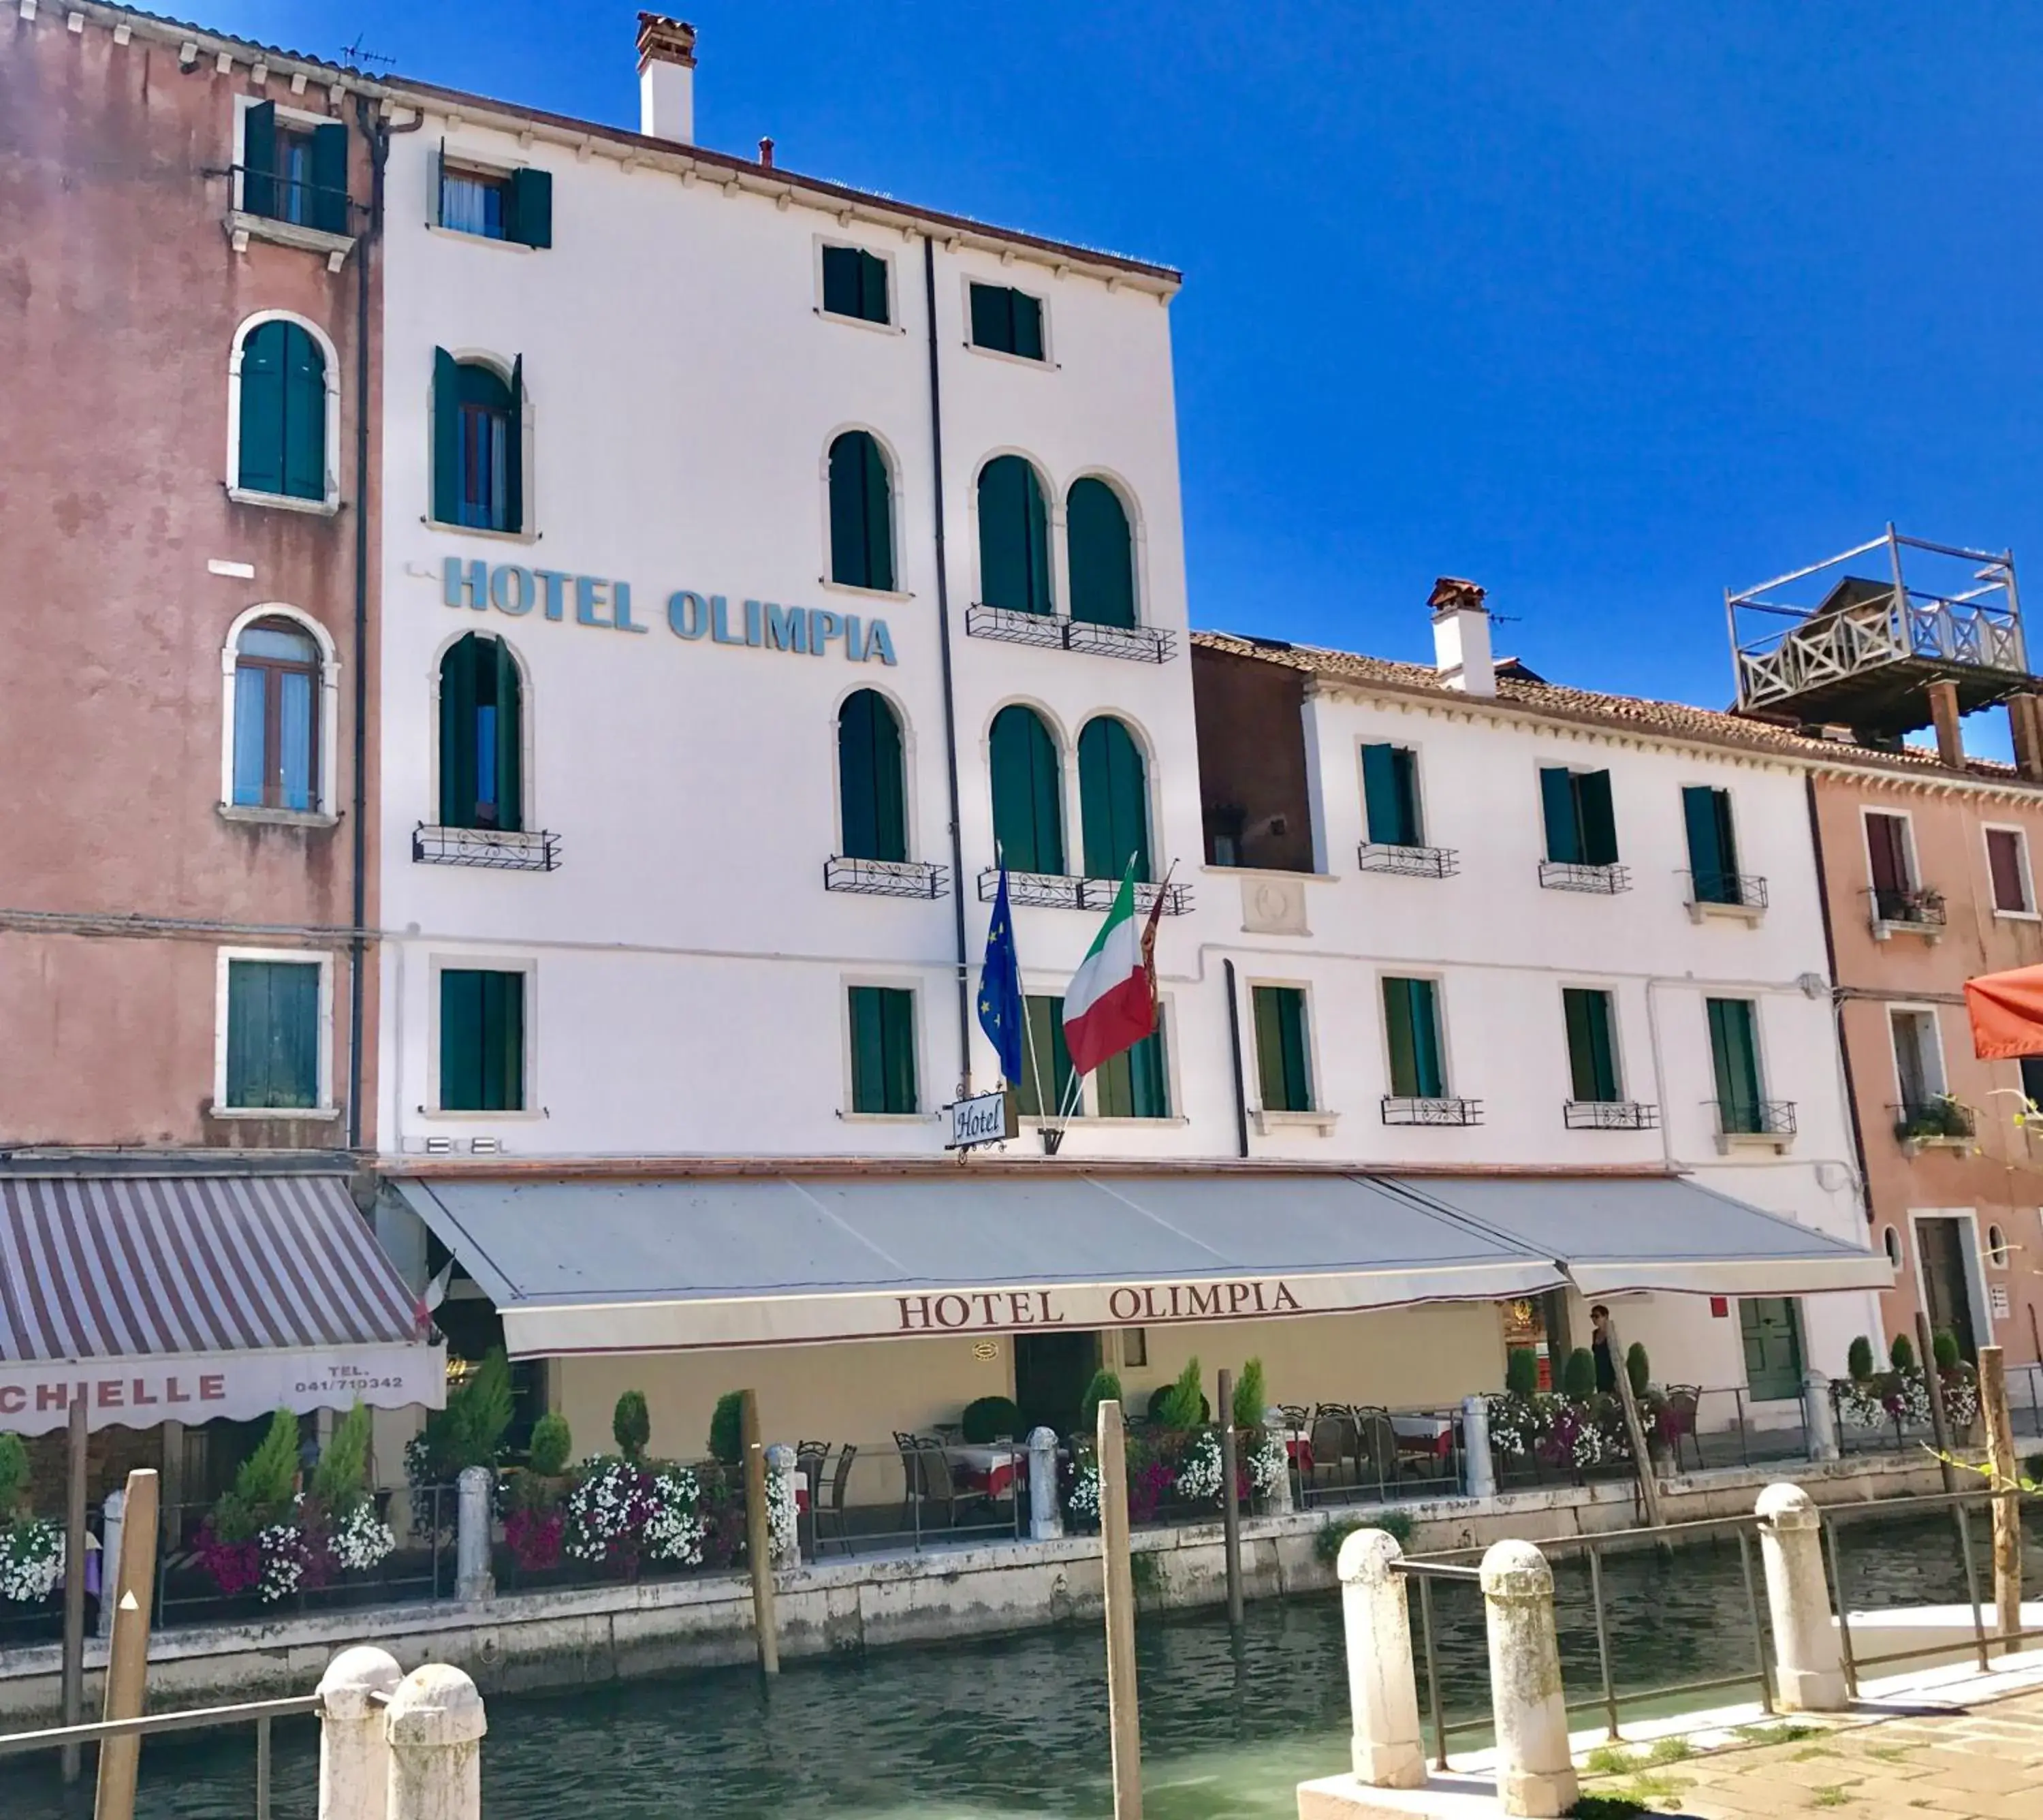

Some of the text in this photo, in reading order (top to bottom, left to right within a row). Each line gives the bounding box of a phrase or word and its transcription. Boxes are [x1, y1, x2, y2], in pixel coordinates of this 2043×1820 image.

[444, 556, 898, 666] HOTEL OLIMPIA
[957, 1099, 1001, 1139] Hotel
[897, 1281, 1301, 1329] HOTEL OLIMPIA
[328, 1366, 369, 1377] TEL.
